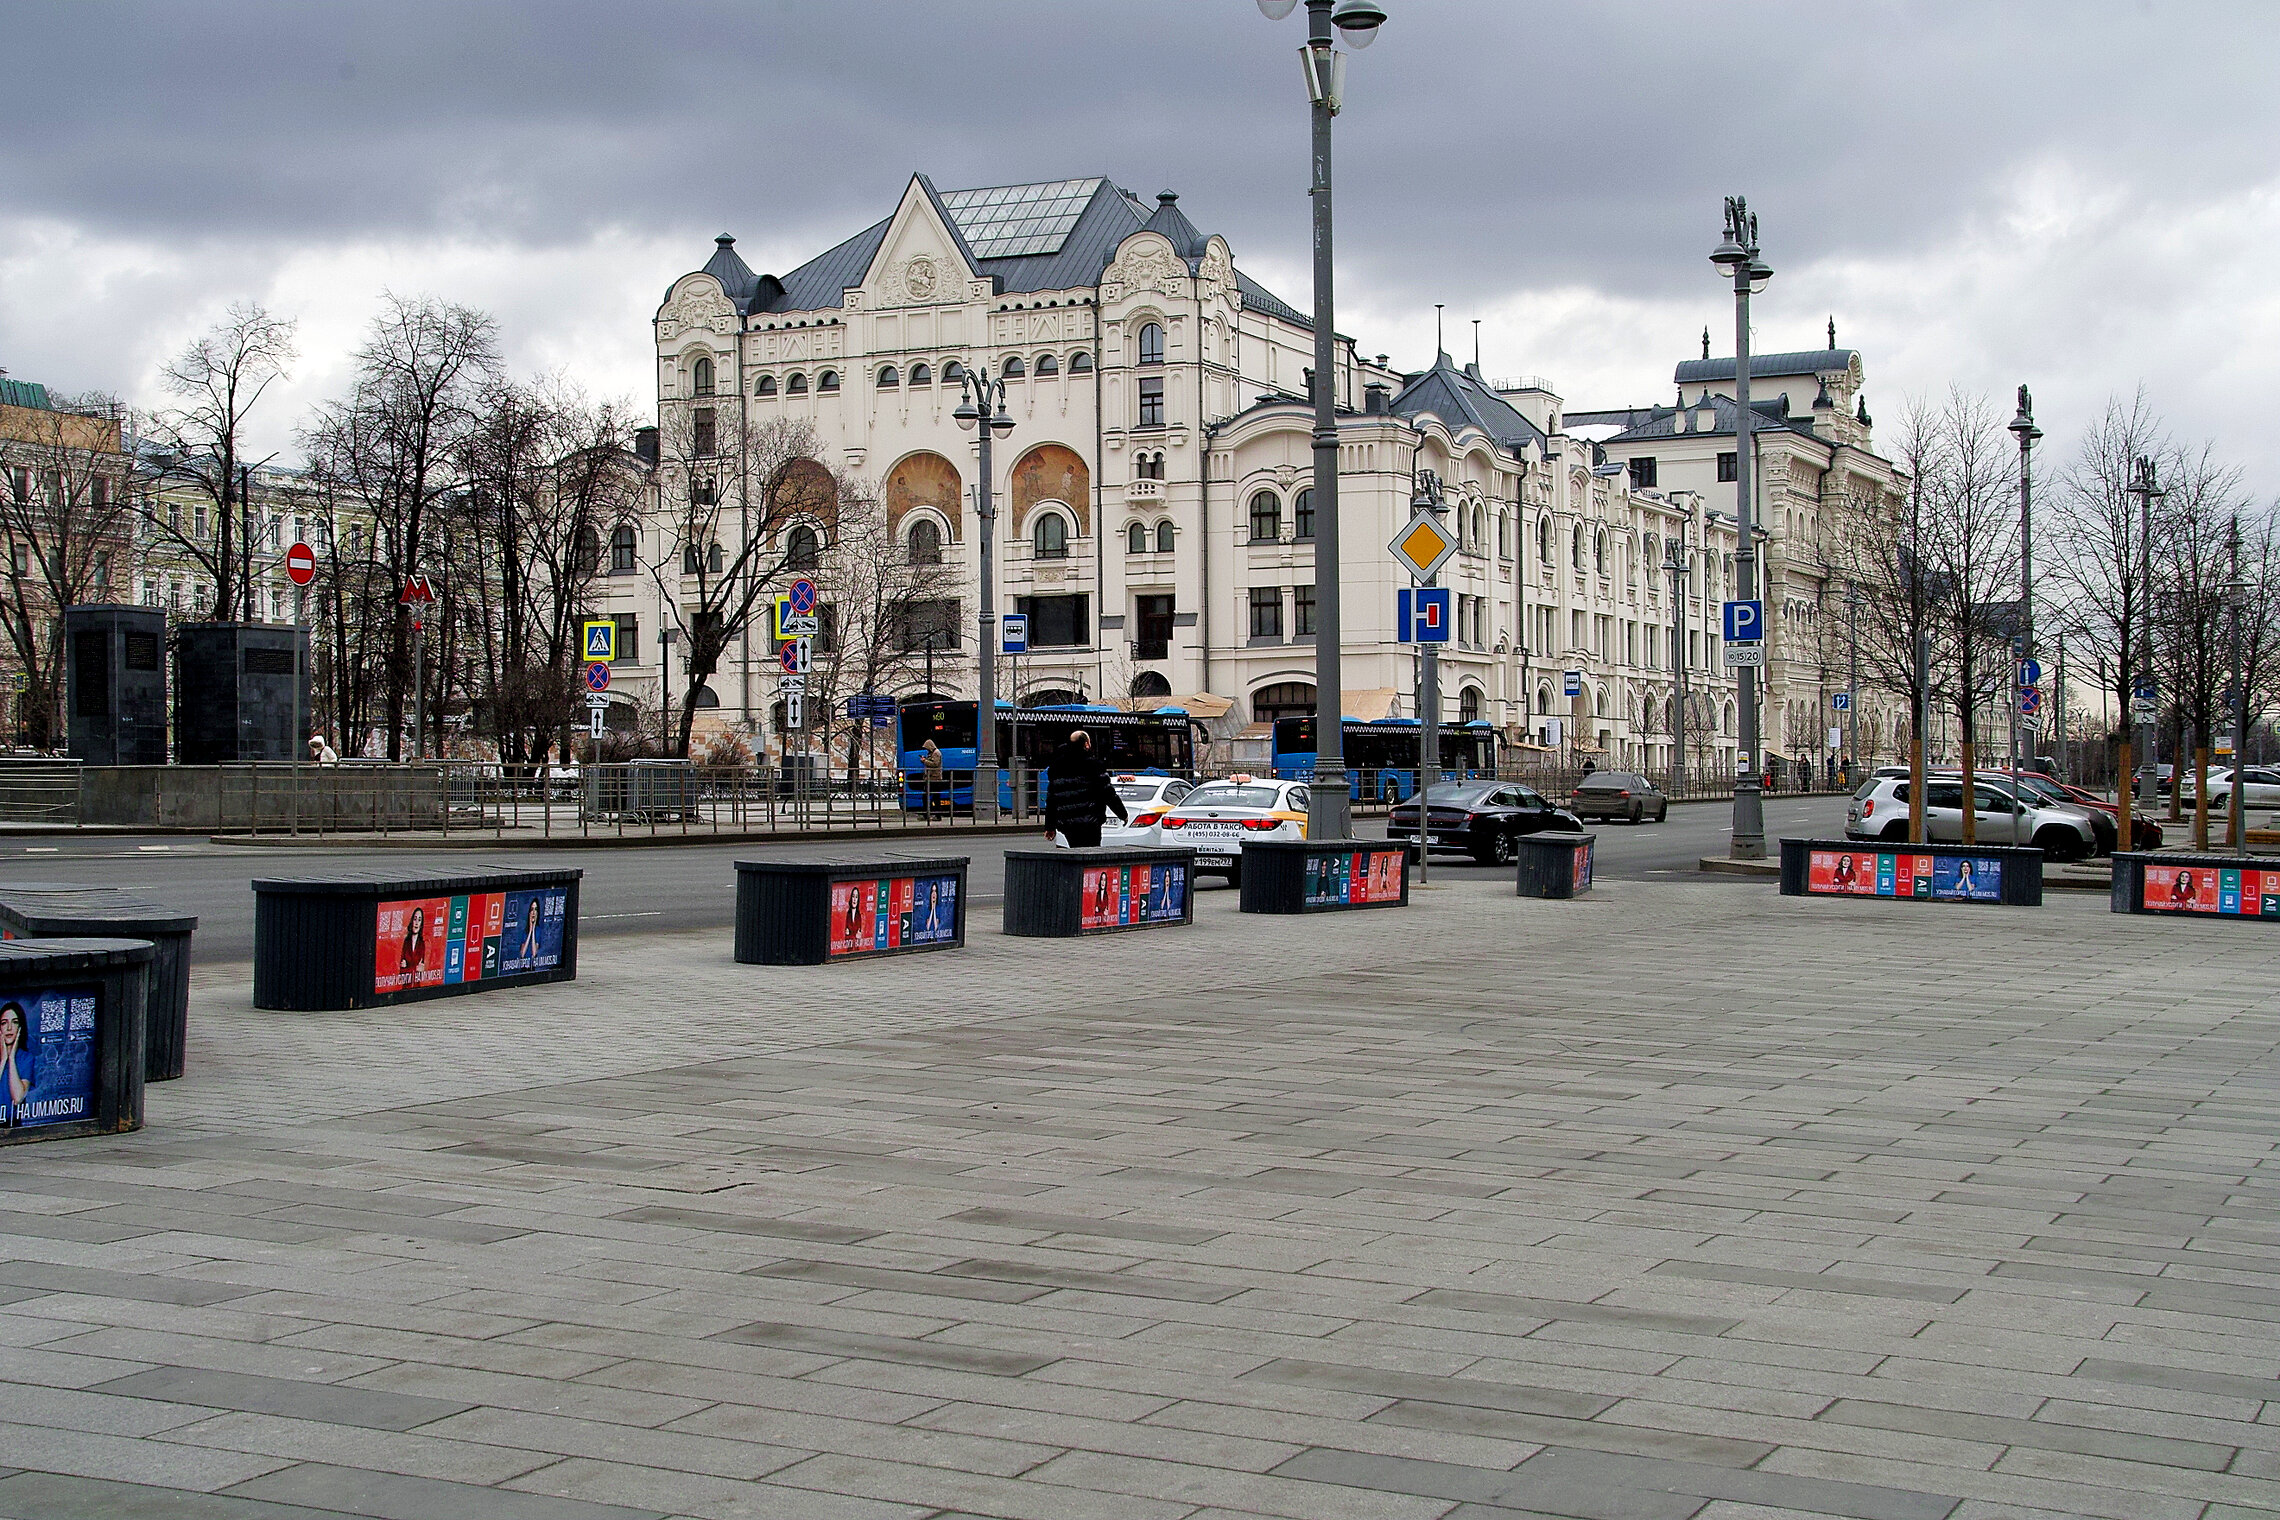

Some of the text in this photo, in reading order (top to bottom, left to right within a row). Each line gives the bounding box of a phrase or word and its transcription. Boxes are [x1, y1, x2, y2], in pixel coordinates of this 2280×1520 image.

[1733, 605, 1755, 637] P
[1736, 652, 1745, 661] 15
[1746, 651, 1759, 661] 20
[17, 1103, 30, 1119] НА
[32, 1097, 83, 1118] UM.MOS.RU
